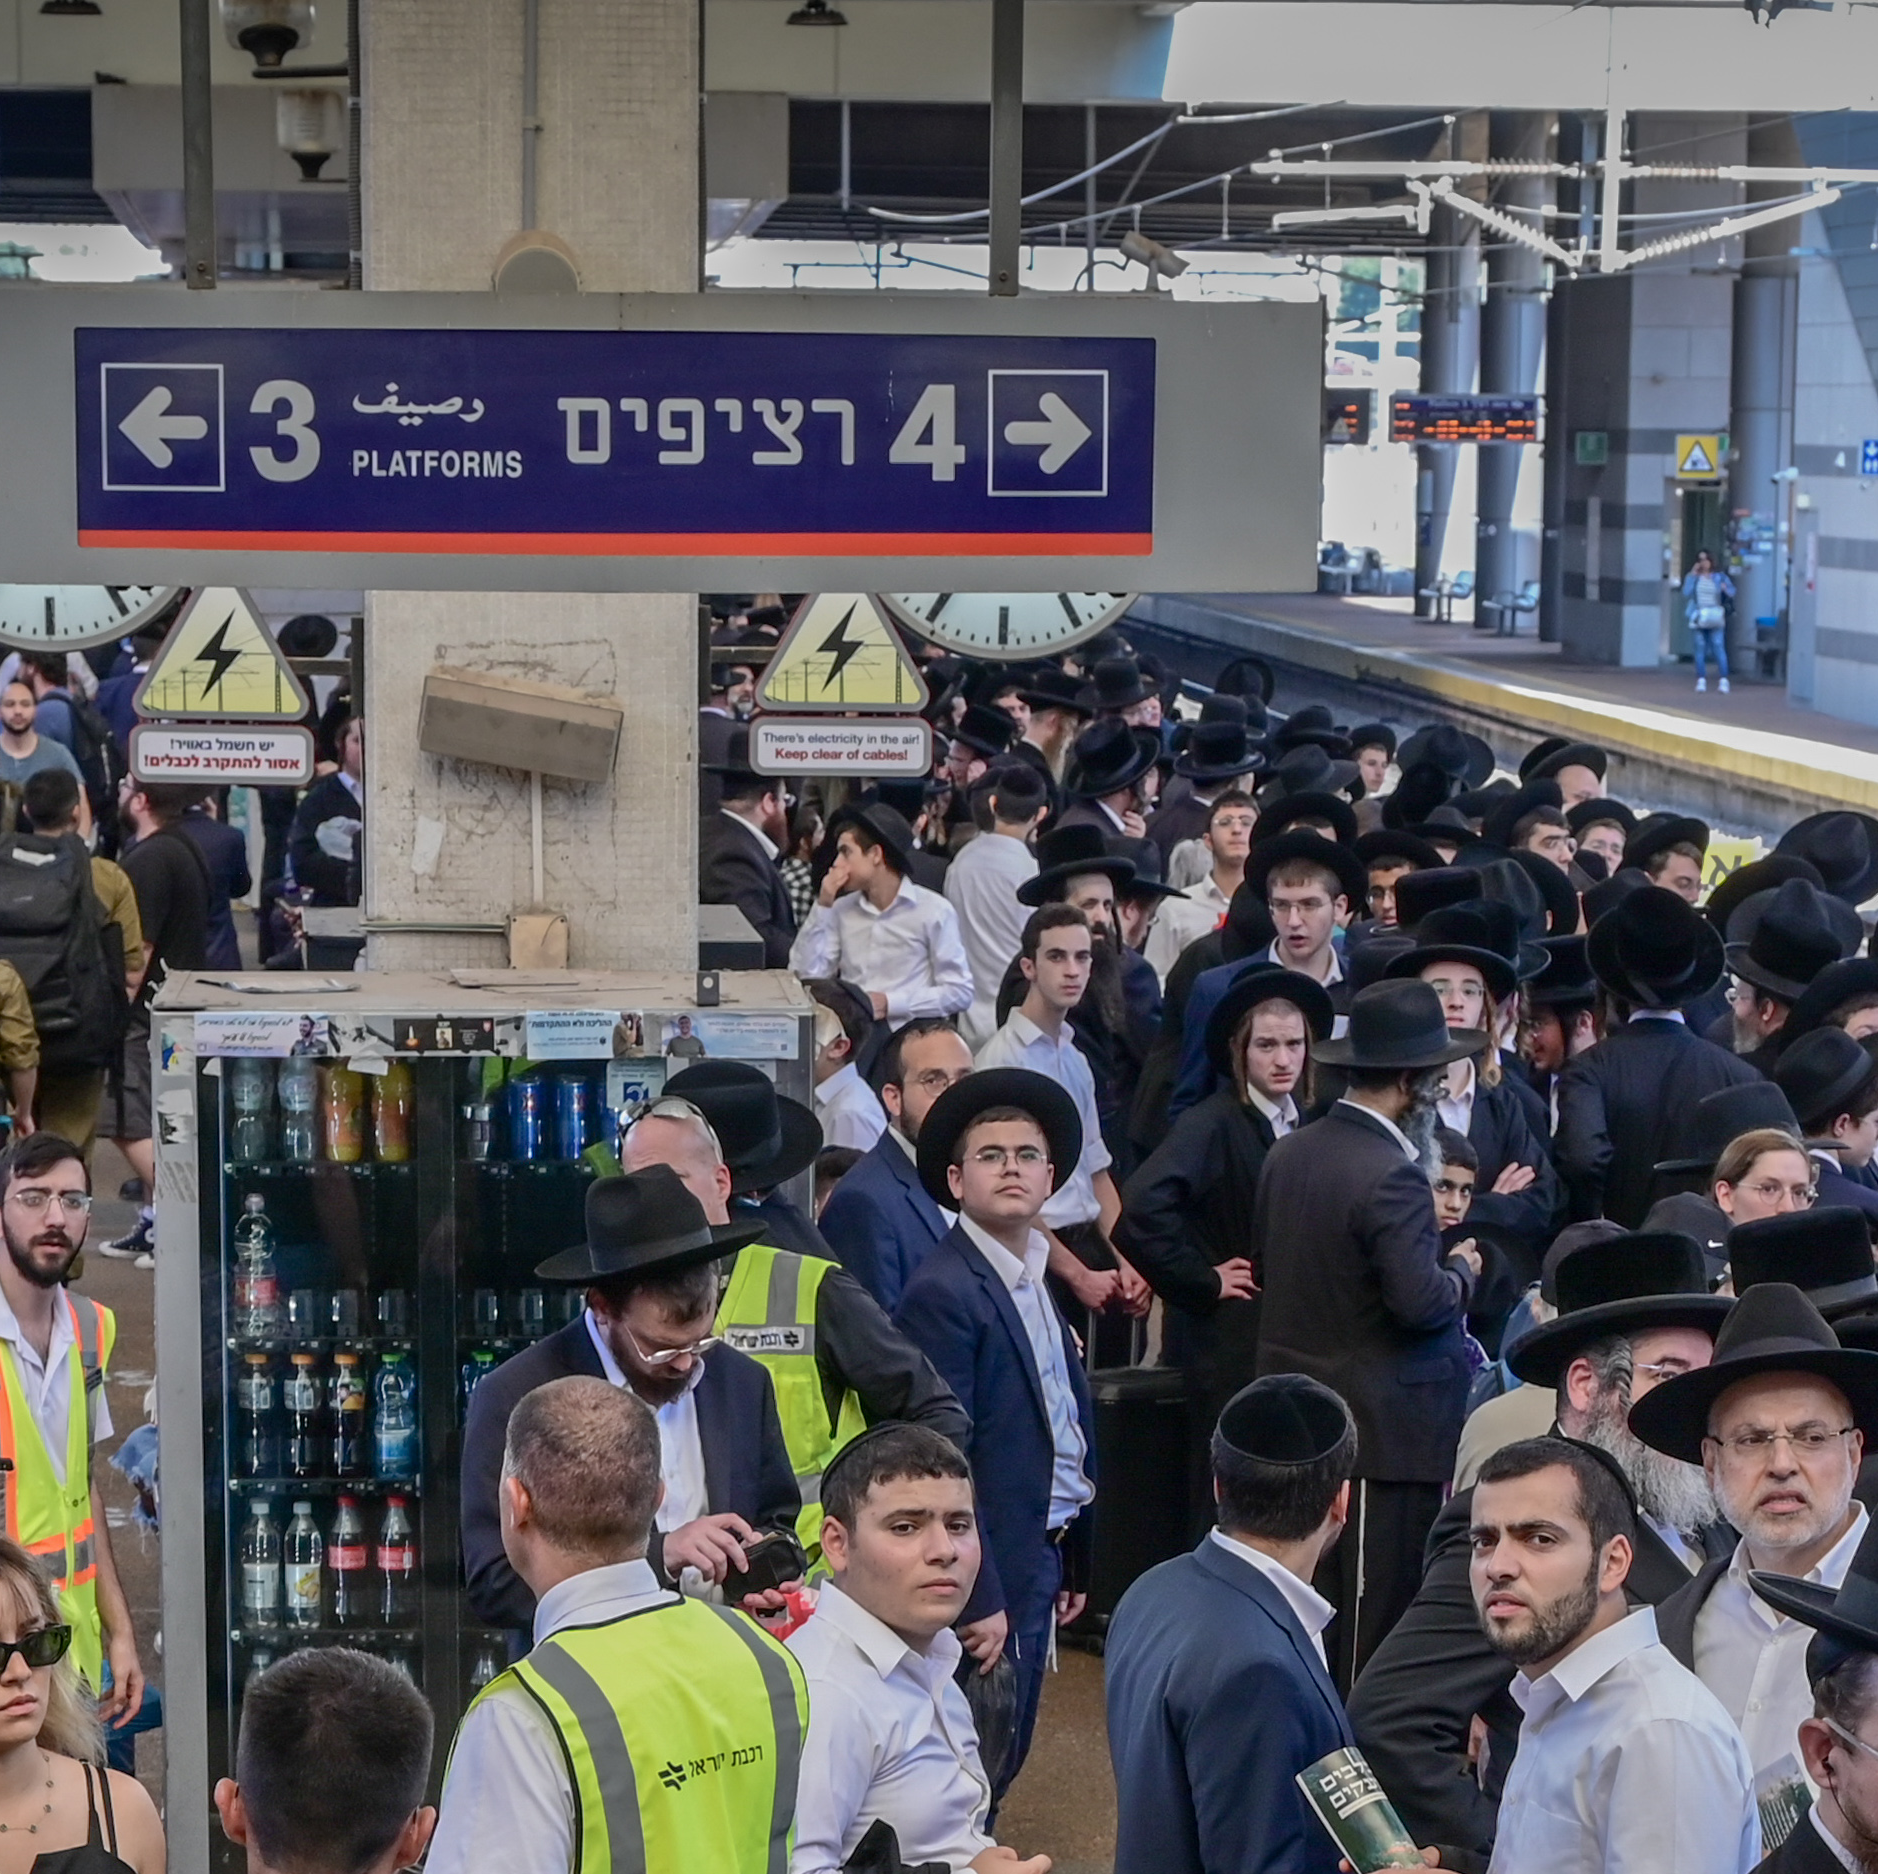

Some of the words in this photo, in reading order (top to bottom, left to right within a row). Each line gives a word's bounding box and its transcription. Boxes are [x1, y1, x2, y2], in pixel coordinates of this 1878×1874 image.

[352, 381, 485, 426] رصيف
[249, 379, 321, 482] 3
[557, 397, 855, 466] רציפים
[888, 383, 966, 482] 4
[352, 450, 523, 478] PLATFORMS
[170, 738, 212, 751] באוויר!
[216, 737, 255, 752] חשמל
[259, 741, 274, 752] יש
[763, 732, 804, 744] There's
[808, 732, 863, 746] electricity
[866, 733, 877, 744] in
[880, 733, 899, 744] the
[902, 734, 920, 745] air!
[144, 754, 199, 769] לכבלים!
[203, 755, 261, 771] להתקרב
[775, 748, 808, 762] Keep
[812, 748, 842, 761] clear
[846, 749, 859, 761] of
[863, 749, 908, 761] cables!
[265, 758, 300, 770] אסור
[731, 1745, 763, 1767] רכבת
[1319, 1747, 1373, 1792] לבים
